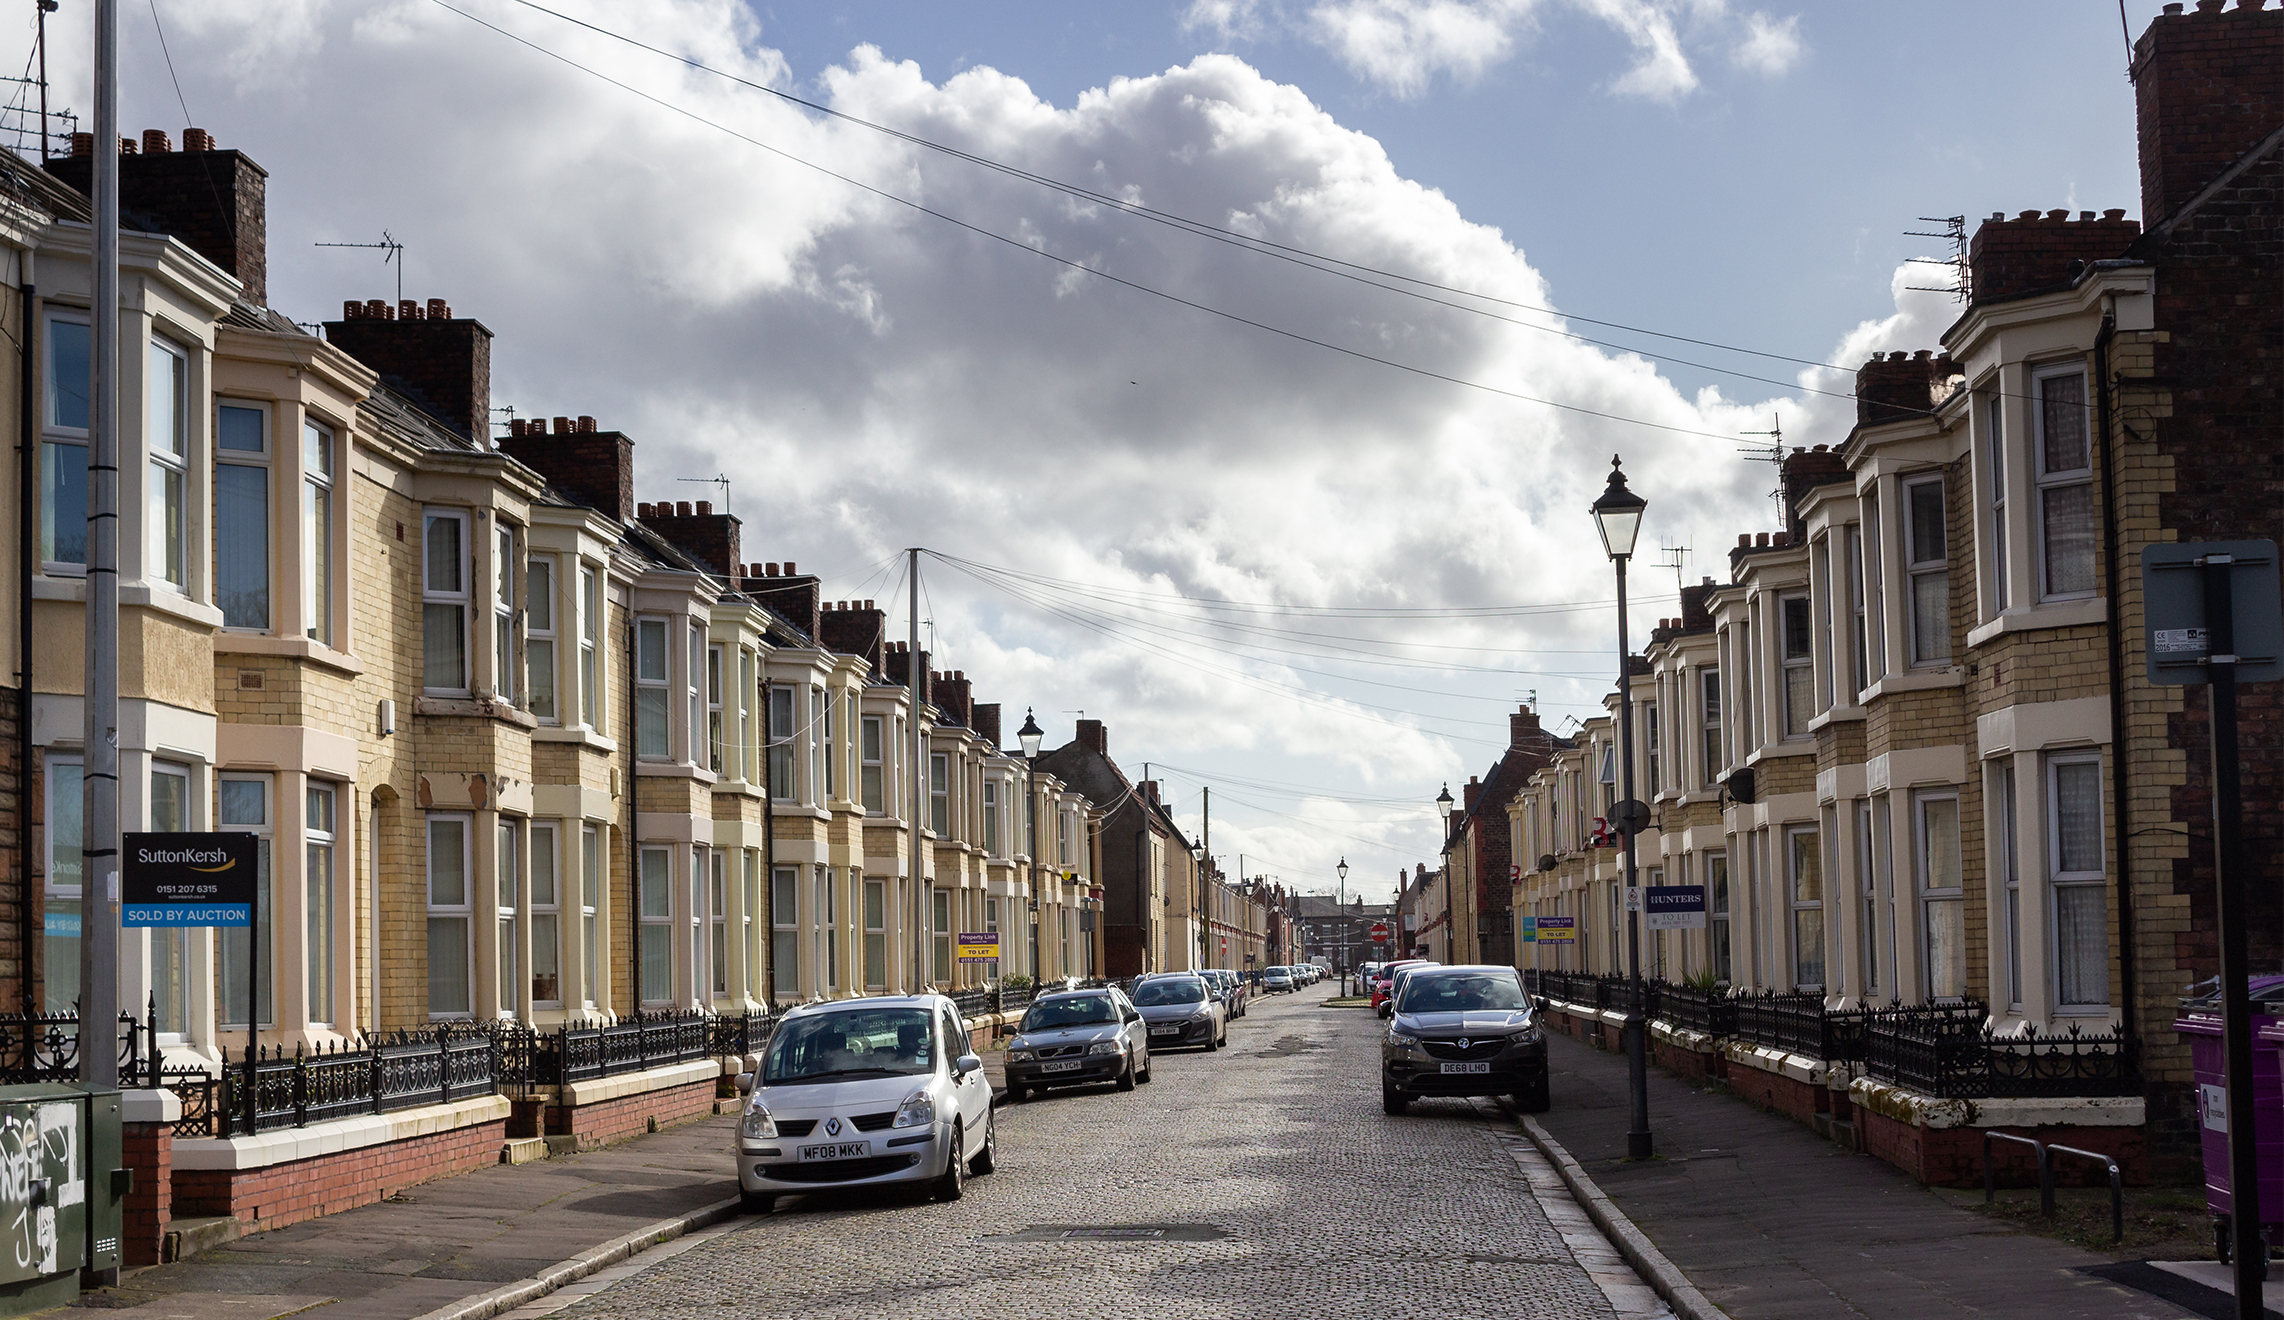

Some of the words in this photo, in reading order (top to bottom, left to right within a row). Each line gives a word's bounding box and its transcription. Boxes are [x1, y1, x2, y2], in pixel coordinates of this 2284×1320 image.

[2156, 643, 2171, 652] 2016
[138, 847, 227, 863] SuttonKersh
[156, 885, 176, 893] 0151
[178, 885, 195, 893] 207
[196, 885, 218, 893] 6315
[1650, 894, 1702, 904] HUNTERS
[128, 910, 163, 921] SOLD
[166, 910, 184, 921] BY
[186, 909, 246, 921] AUCTION
[1661, 913, 1674, 921] TO
[1044, 1063, 1063, 1071] NG04
[1064, 1061, 1079, 1069] YCH
[1444, 1064, 1467, 1072] DE68
[1469, 1064, 1486, 1072] LHO
[804, 1145, 836, 1159] MF08
[839, 1143, 864, 1156] MKK
